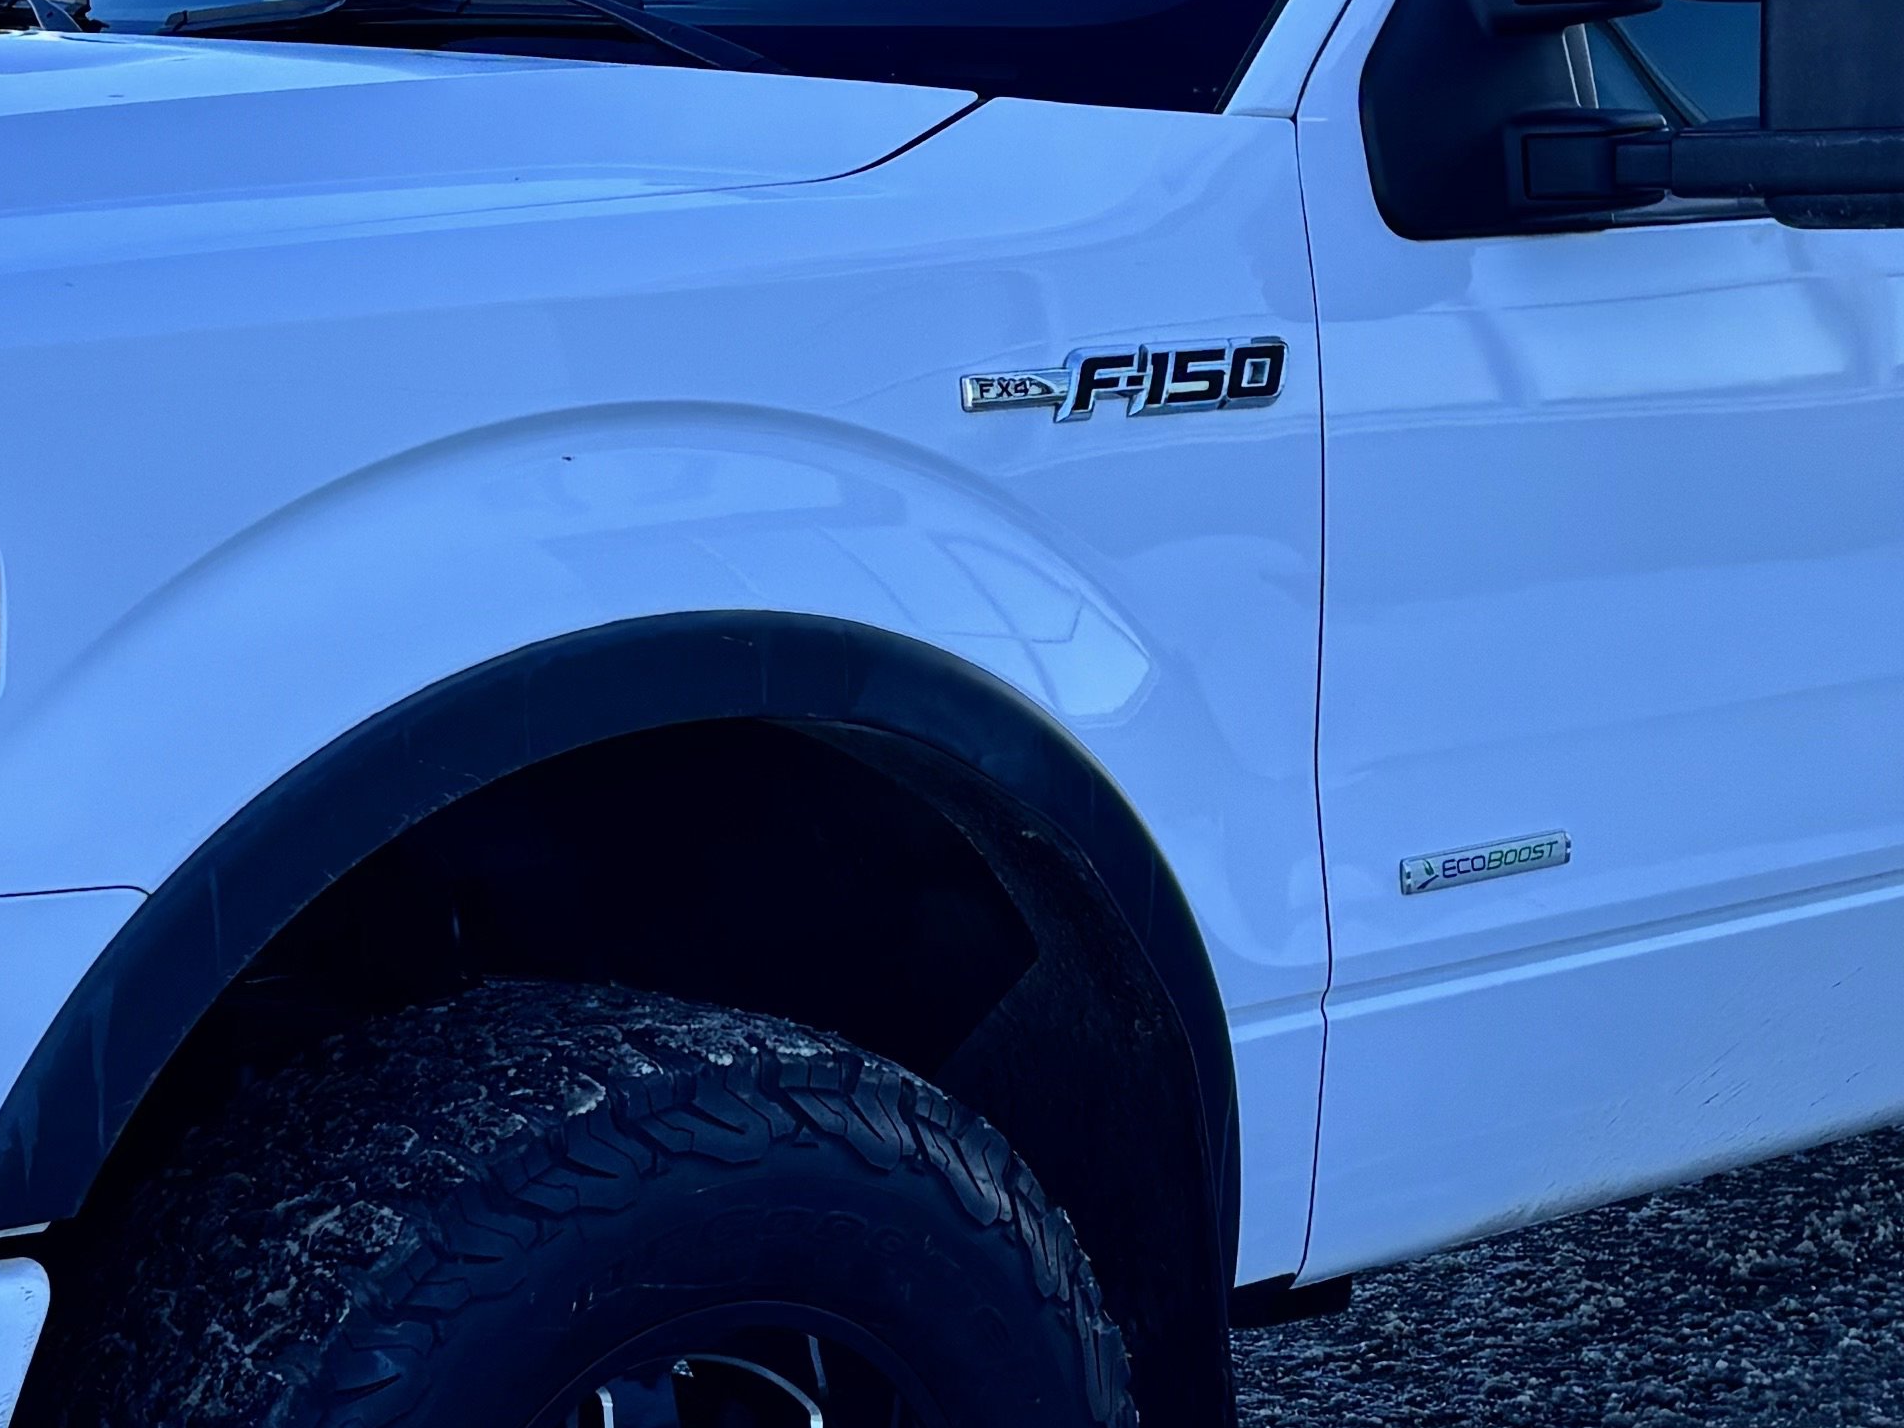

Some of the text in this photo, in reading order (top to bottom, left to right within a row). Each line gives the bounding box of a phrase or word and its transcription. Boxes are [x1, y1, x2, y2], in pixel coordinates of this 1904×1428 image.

[978, 376, 1032, 398] FX4
[1066, 340, 1287, 416] F-150
[1442, 841, 1559, 879] ECOBOOST
